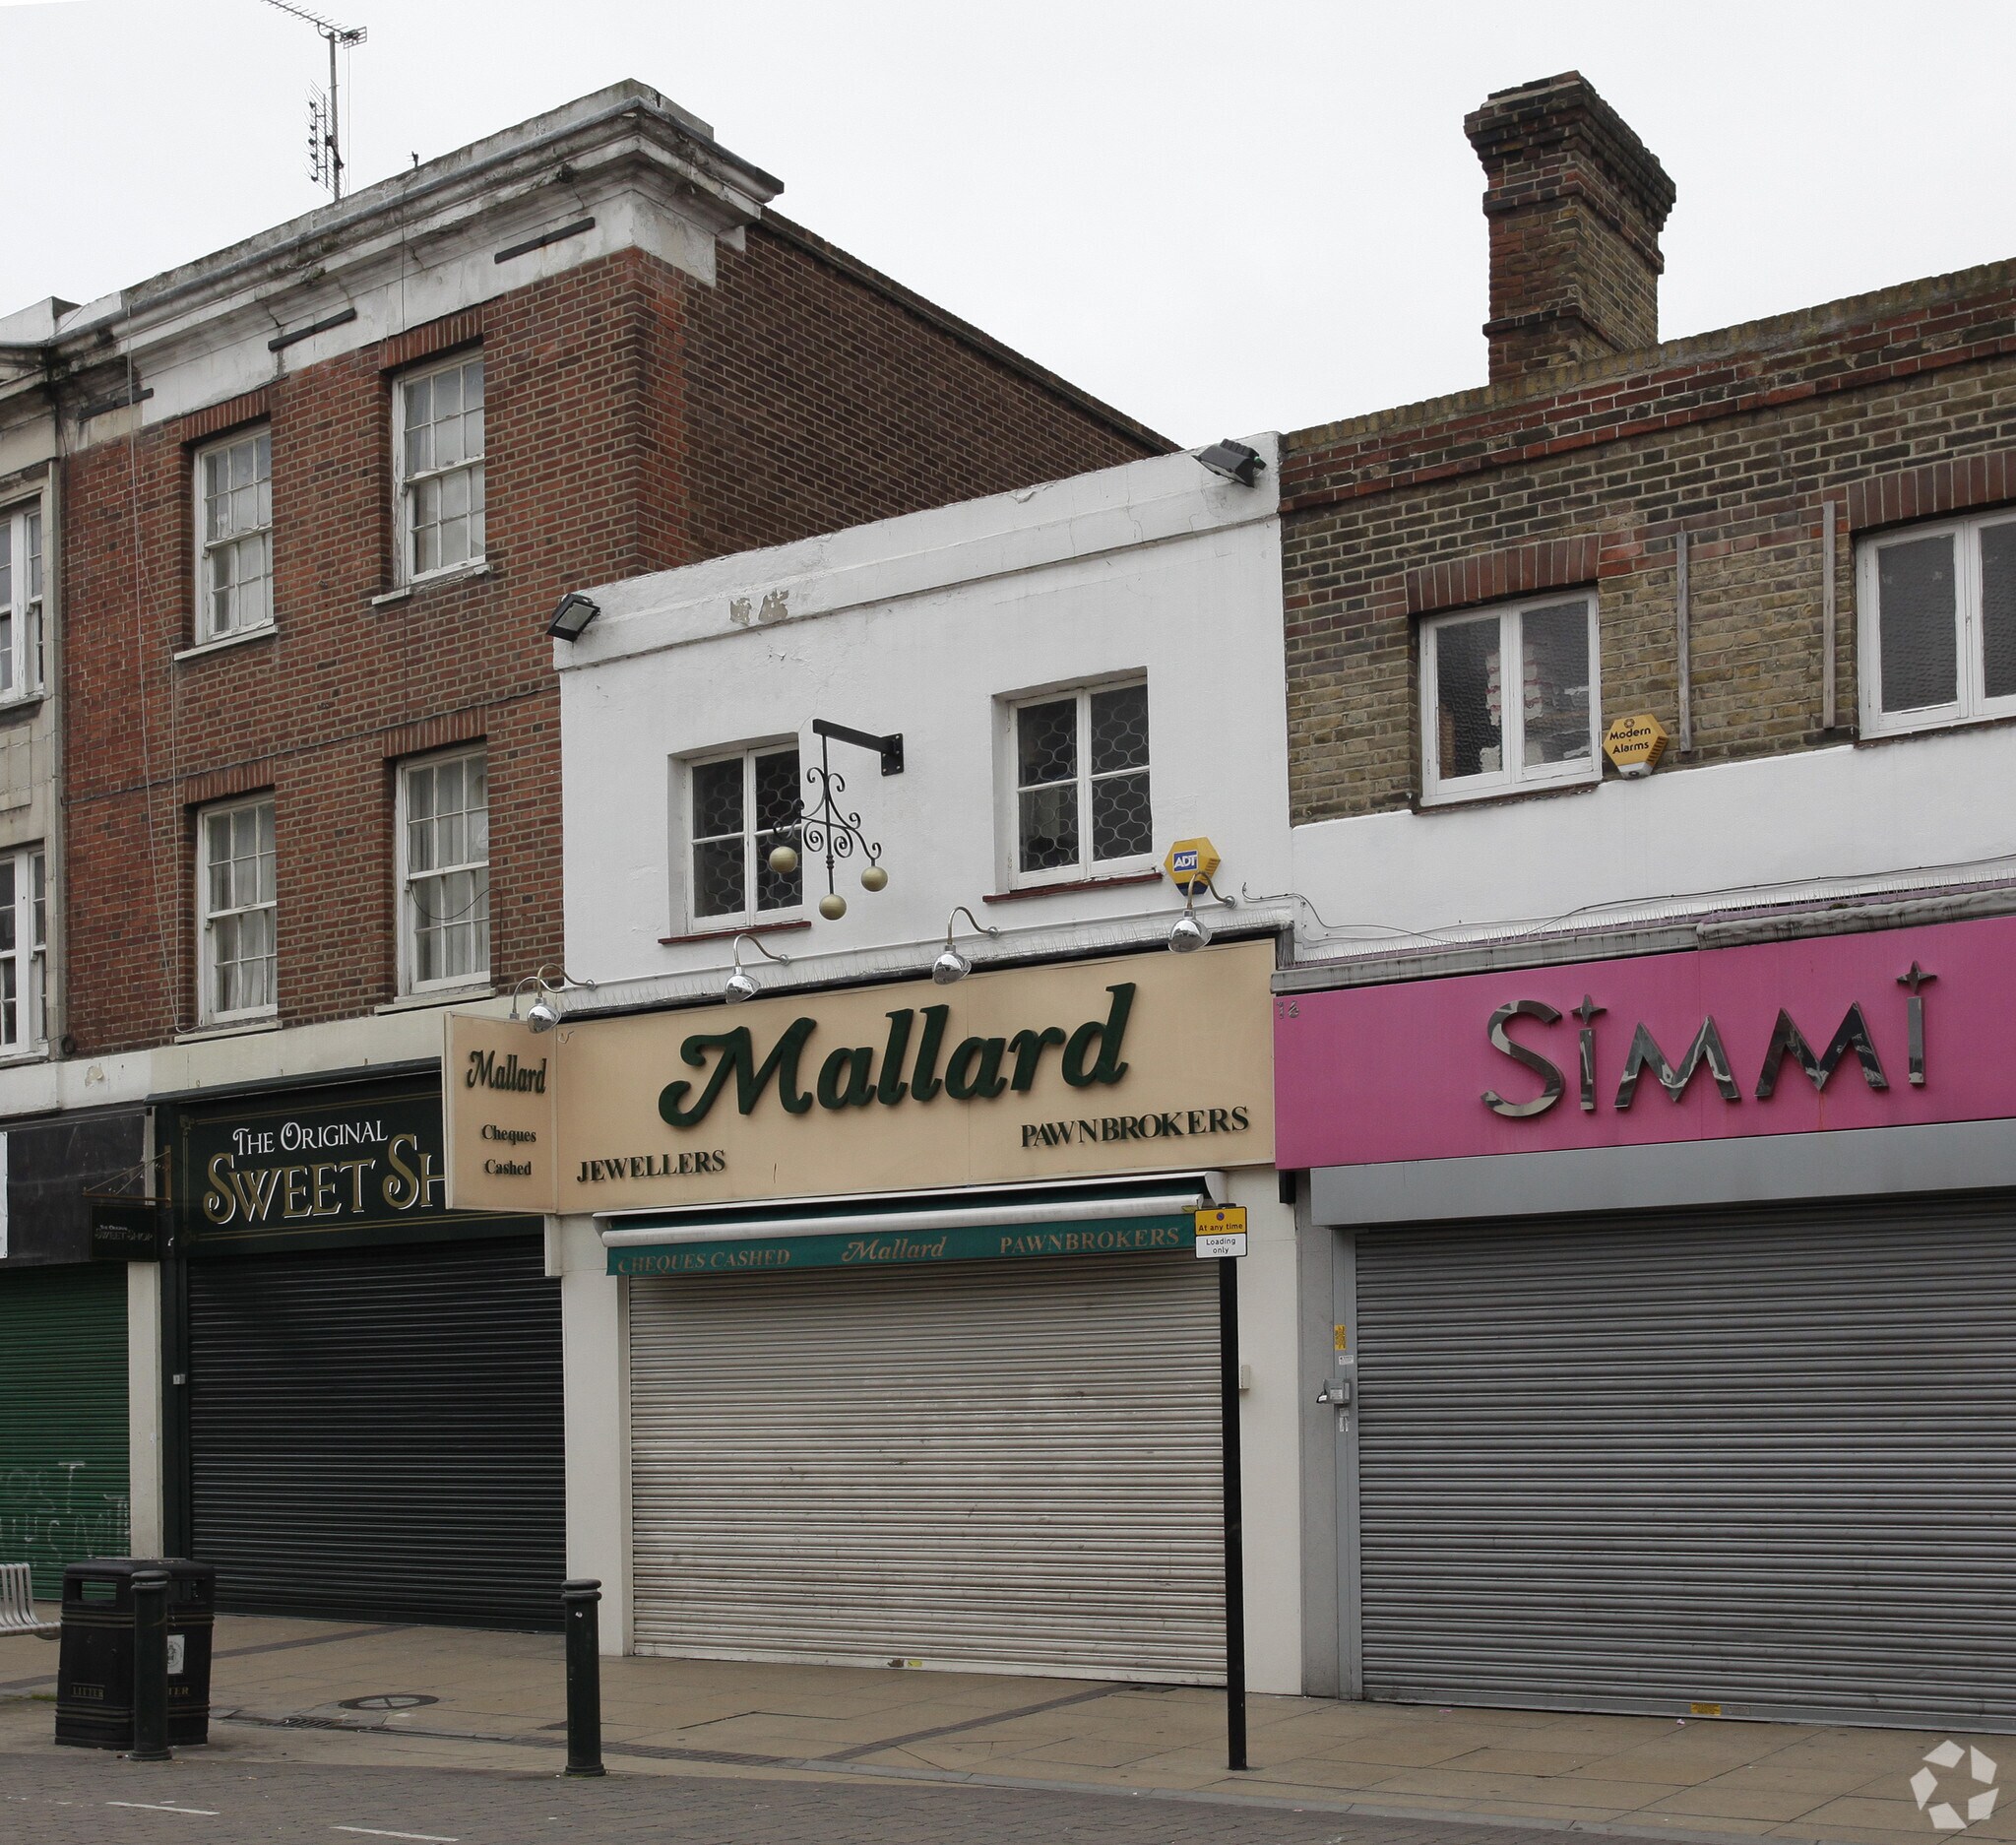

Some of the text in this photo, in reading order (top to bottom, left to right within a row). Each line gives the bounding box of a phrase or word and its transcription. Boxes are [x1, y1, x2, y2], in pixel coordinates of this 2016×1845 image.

[1609, 728, 1651, 740] Modern
[1612, 741, 1649, 754] Alarms
[1173, 854, 1198, 868] ADT
[658, 982, 1137, 1128] Mallard
[467, 1050, 547, 1094] Mallard
[232, 1120, 388, 1156] THE ORIGINAL
[481, 1123, 536, 1145] Cheques
[1021, 1106, 1250, 1148] PAWNBROKERS
[203, 1133, 445, 1224] SWEET SH
[484, 1159, 532, 1176] Cashed
[577, 1149, 726, 1183] JEWELLERS
[841, 1237, 947, 1262] Mallard
[1000, 1228, 1179, 1254] PAWNBROKERS
[617, 1248, 790, 1274] CHEQUES CASHED
[72, 1686, 103, 1698] LITTER
[168, 1686, 189, 1695] TER
